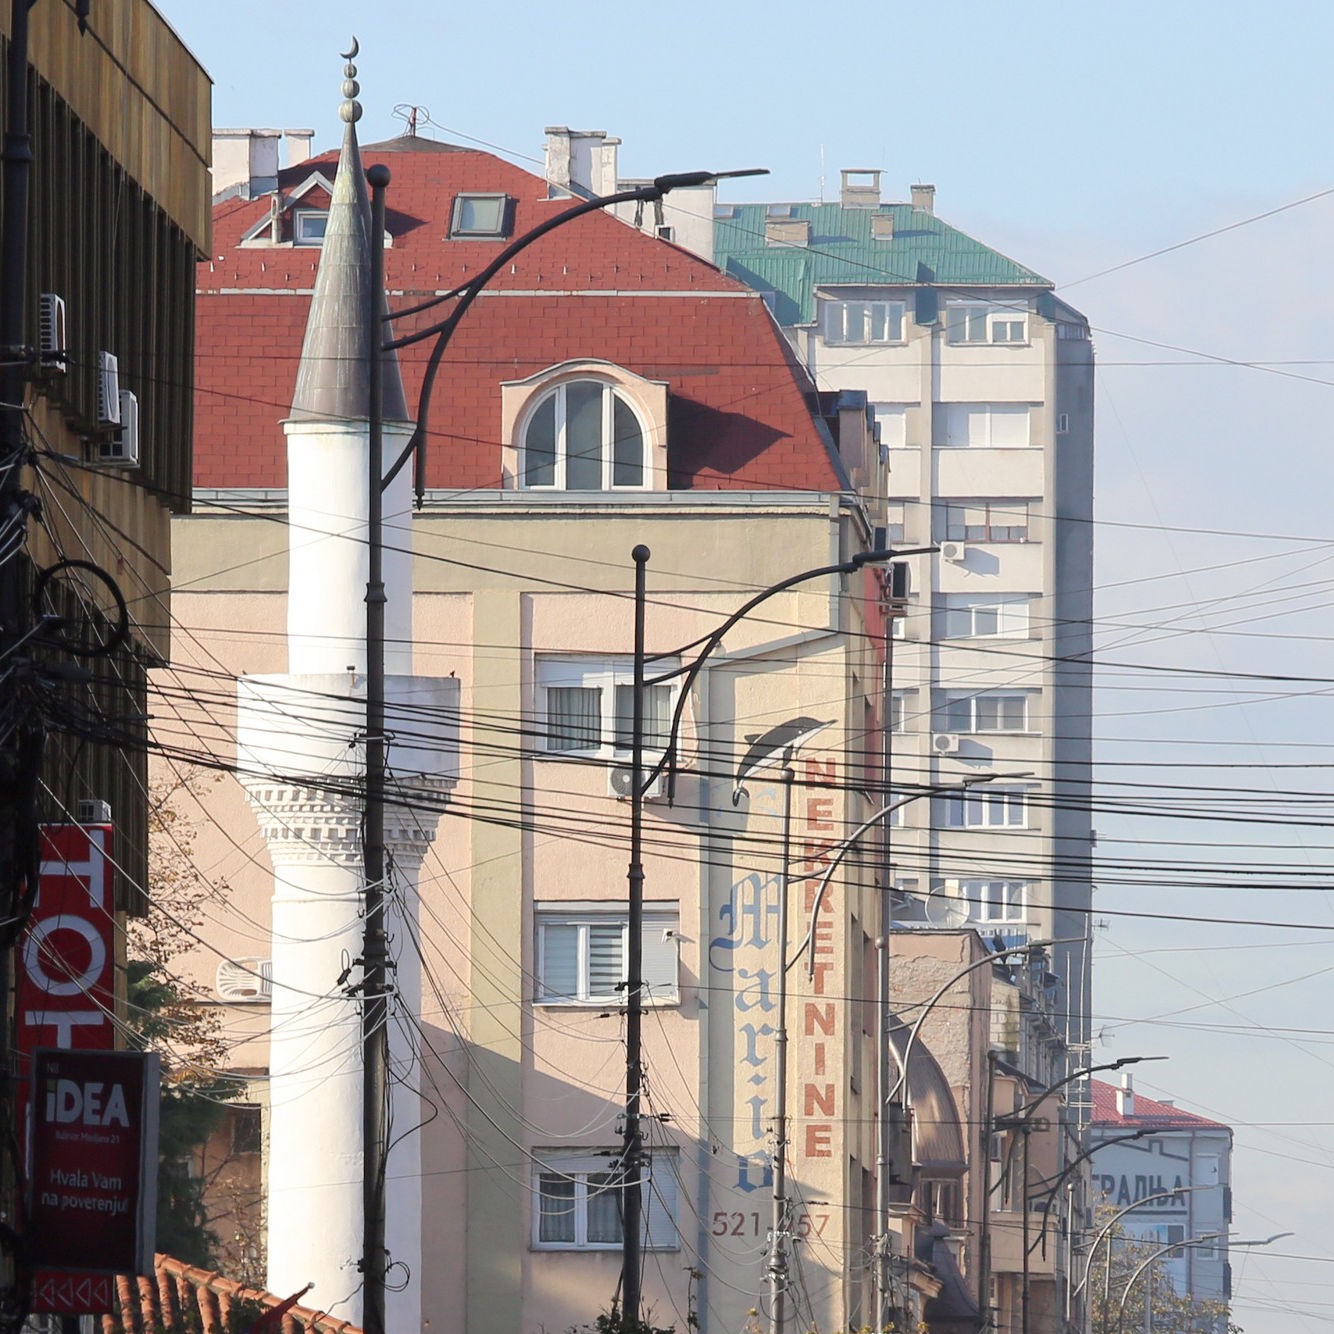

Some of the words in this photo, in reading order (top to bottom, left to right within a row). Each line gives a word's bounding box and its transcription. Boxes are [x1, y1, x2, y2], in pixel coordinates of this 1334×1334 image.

[804, 758, 836, 1157] NEKRETNINE
[50, 1169, 89, 1188] Hvala
[92, 1171, 122, 1190] Vam
[41, 1191, 58, 1206] na
[713, 1212, 831, 1238] 521-57
